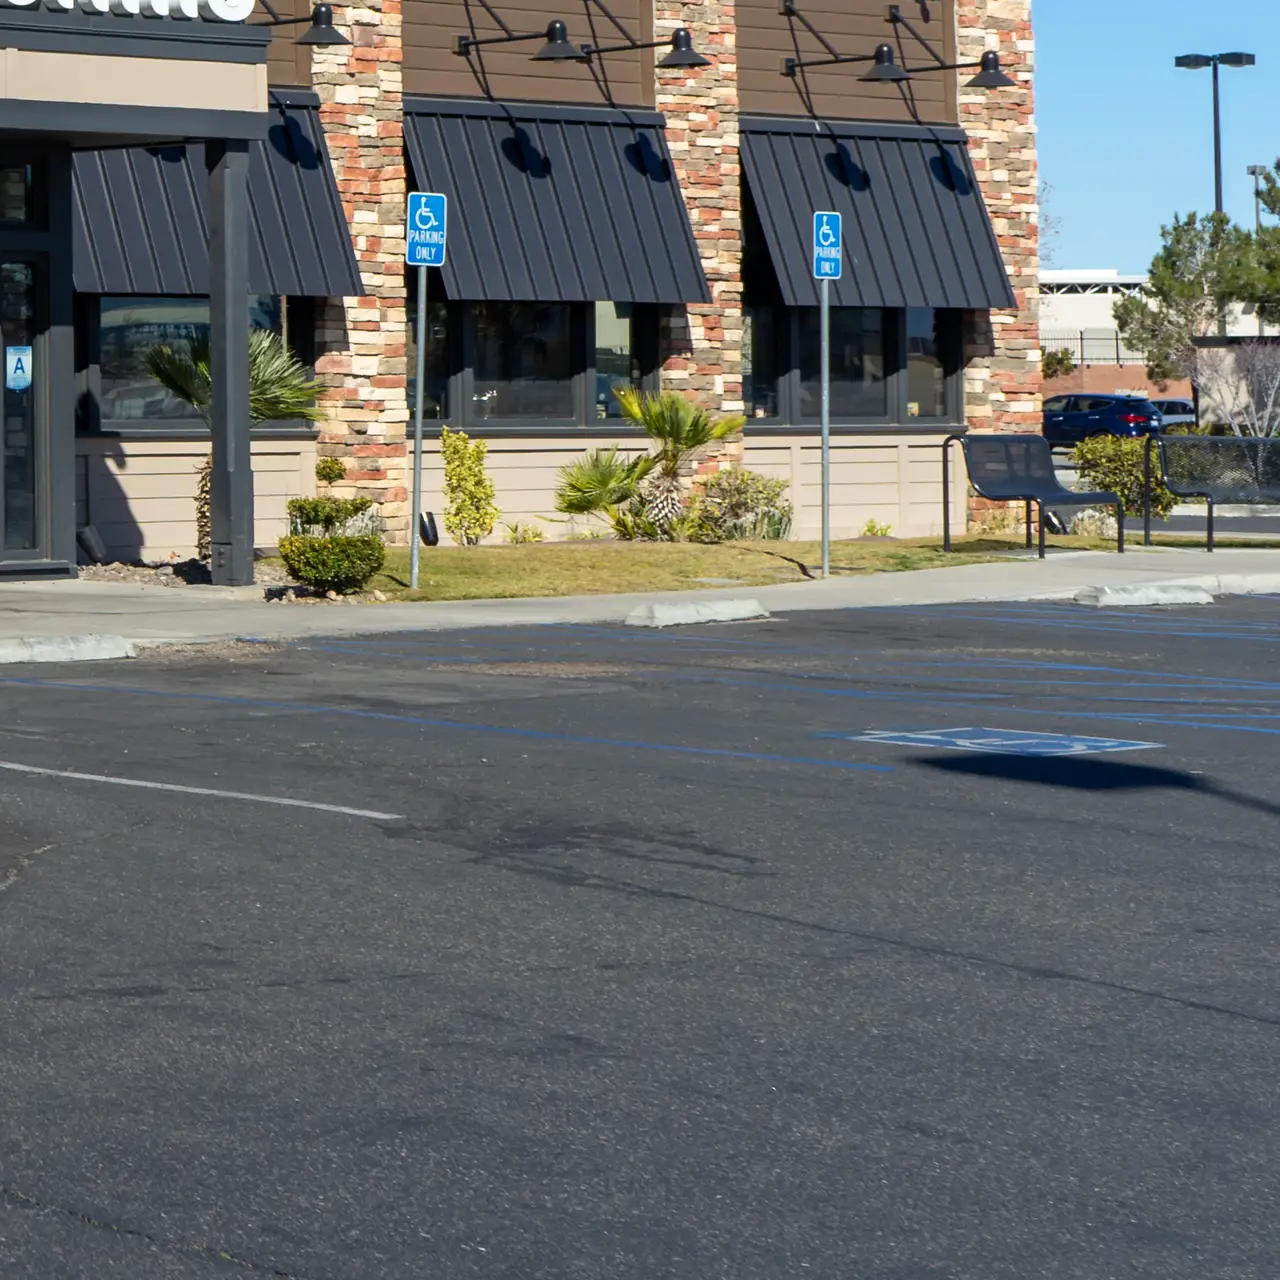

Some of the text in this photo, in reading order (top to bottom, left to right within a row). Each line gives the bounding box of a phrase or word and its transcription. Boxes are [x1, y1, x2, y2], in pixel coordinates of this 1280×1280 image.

[409, 230, 444, 244] PARKING
[416, 246, 436, 260] ONLY
[14, 357, 26, 374] A
